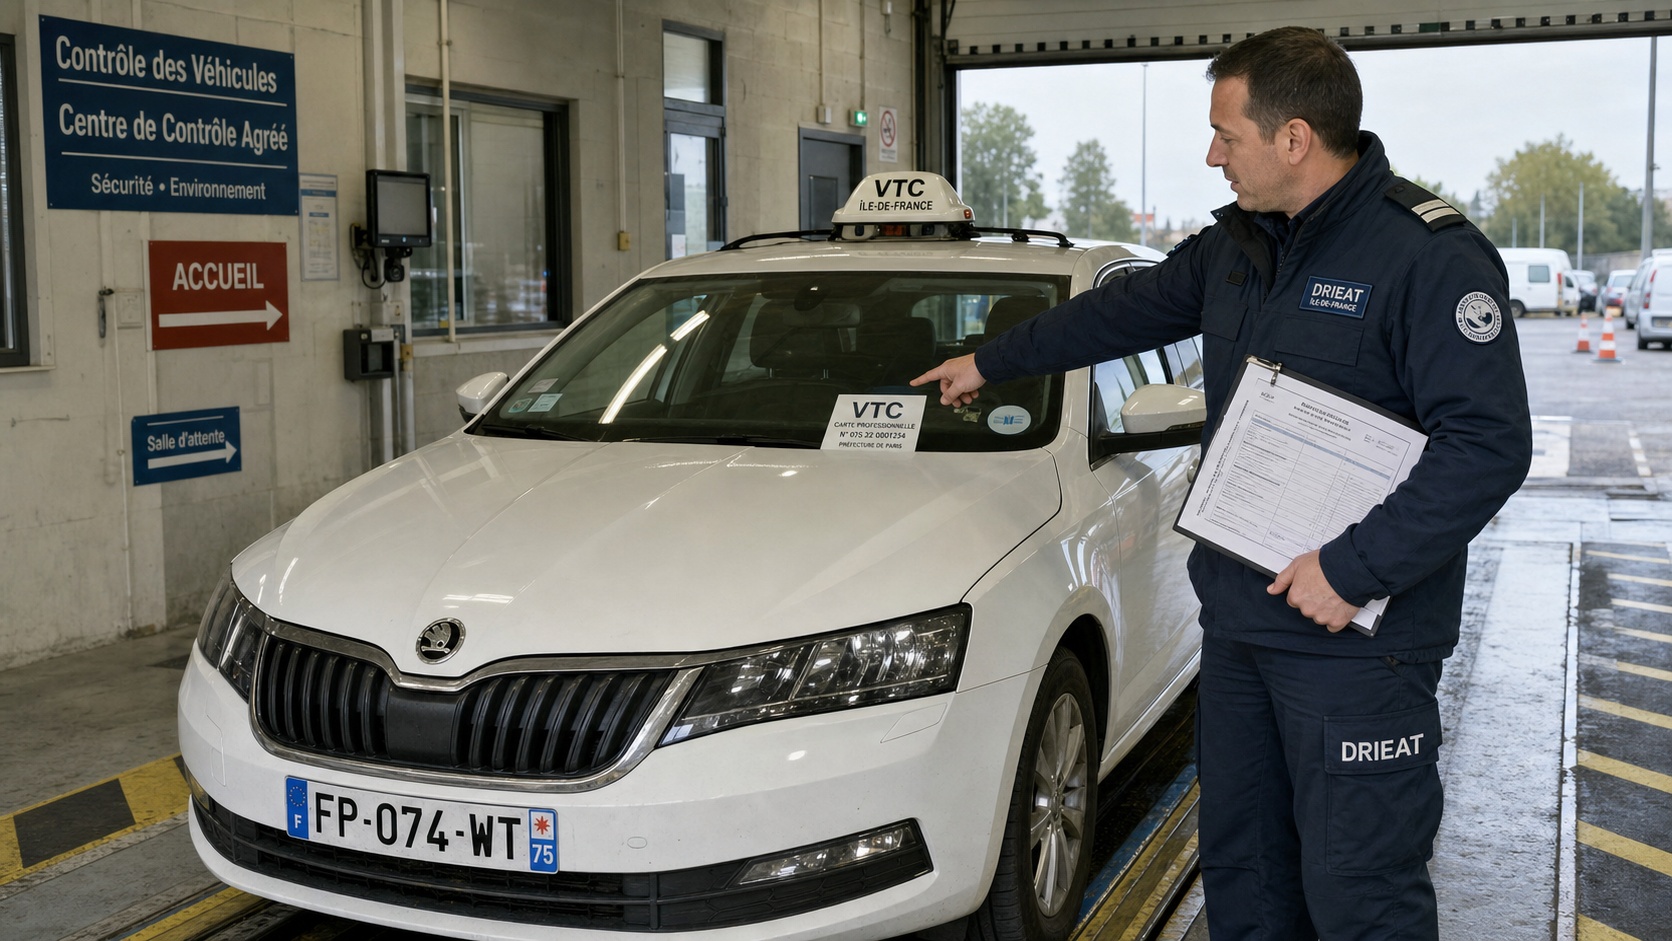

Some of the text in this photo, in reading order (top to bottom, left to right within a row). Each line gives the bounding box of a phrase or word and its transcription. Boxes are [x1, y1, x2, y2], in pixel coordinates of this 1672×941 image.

[55, 35, 277, 94] Contrôle des Véhicules
[59, 103, 288, 156] Centre de Contrôle Agréé
[91, 172, 266, 200] Sécurité Environnement
[875, 178, 926, 198] VTC
[172, 262, 264, 291] ACCUEIL
[1311, 282, 1365, 303] DRIEAT
[852, 401, 904, 420] VTC
[147, 429, 225, 452] Salle d'attente
[1341, 733, 1424, 762] DRIEAT
[294, 814, 302, 829] F
[315, 791, 521, 860] FP-074-WT
[532, 844, 554, 865] 75
